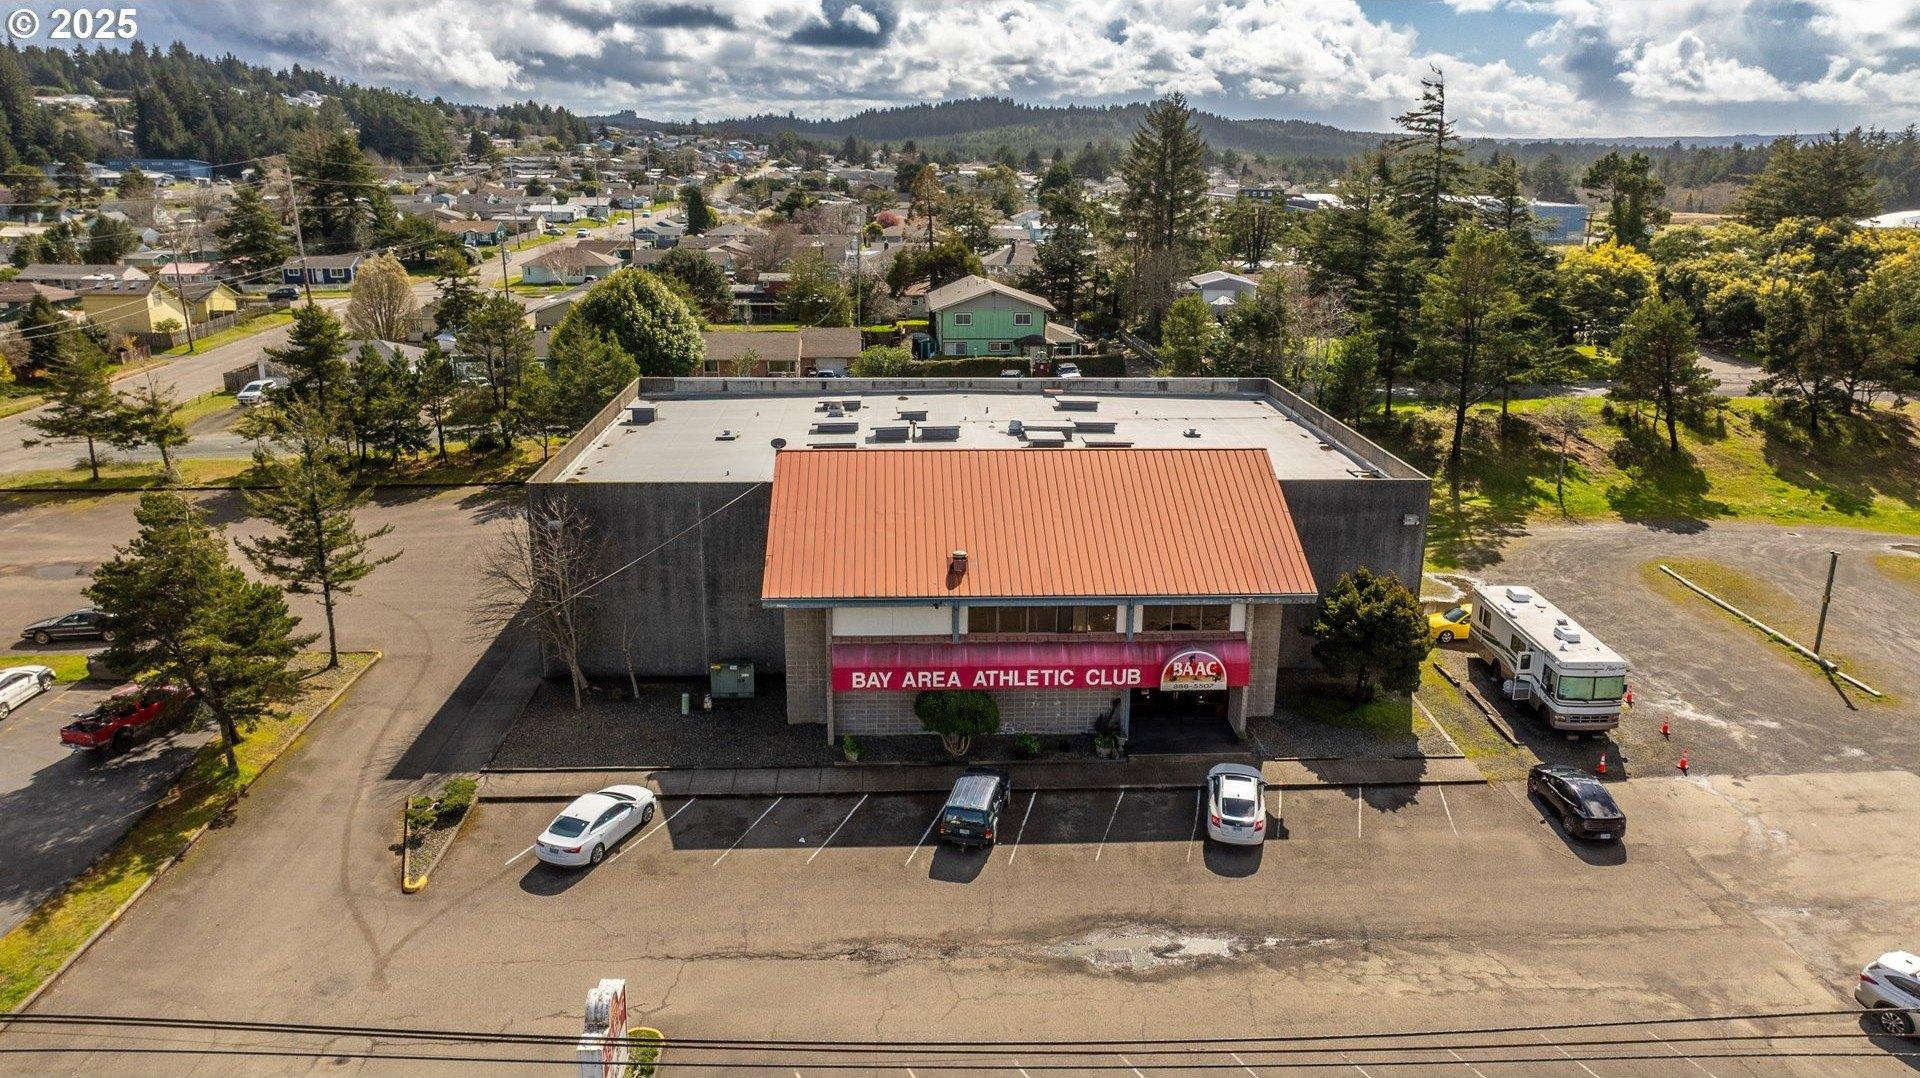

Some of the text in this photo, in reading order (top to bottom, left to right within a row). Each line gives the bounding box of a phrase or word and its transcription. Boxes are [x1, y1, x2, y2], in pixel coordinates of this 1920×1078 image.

[1172, 661, 1217, 676] BAAC
[851, 668, 1141, 688] BAY AREA ATHLETIC CLUB
